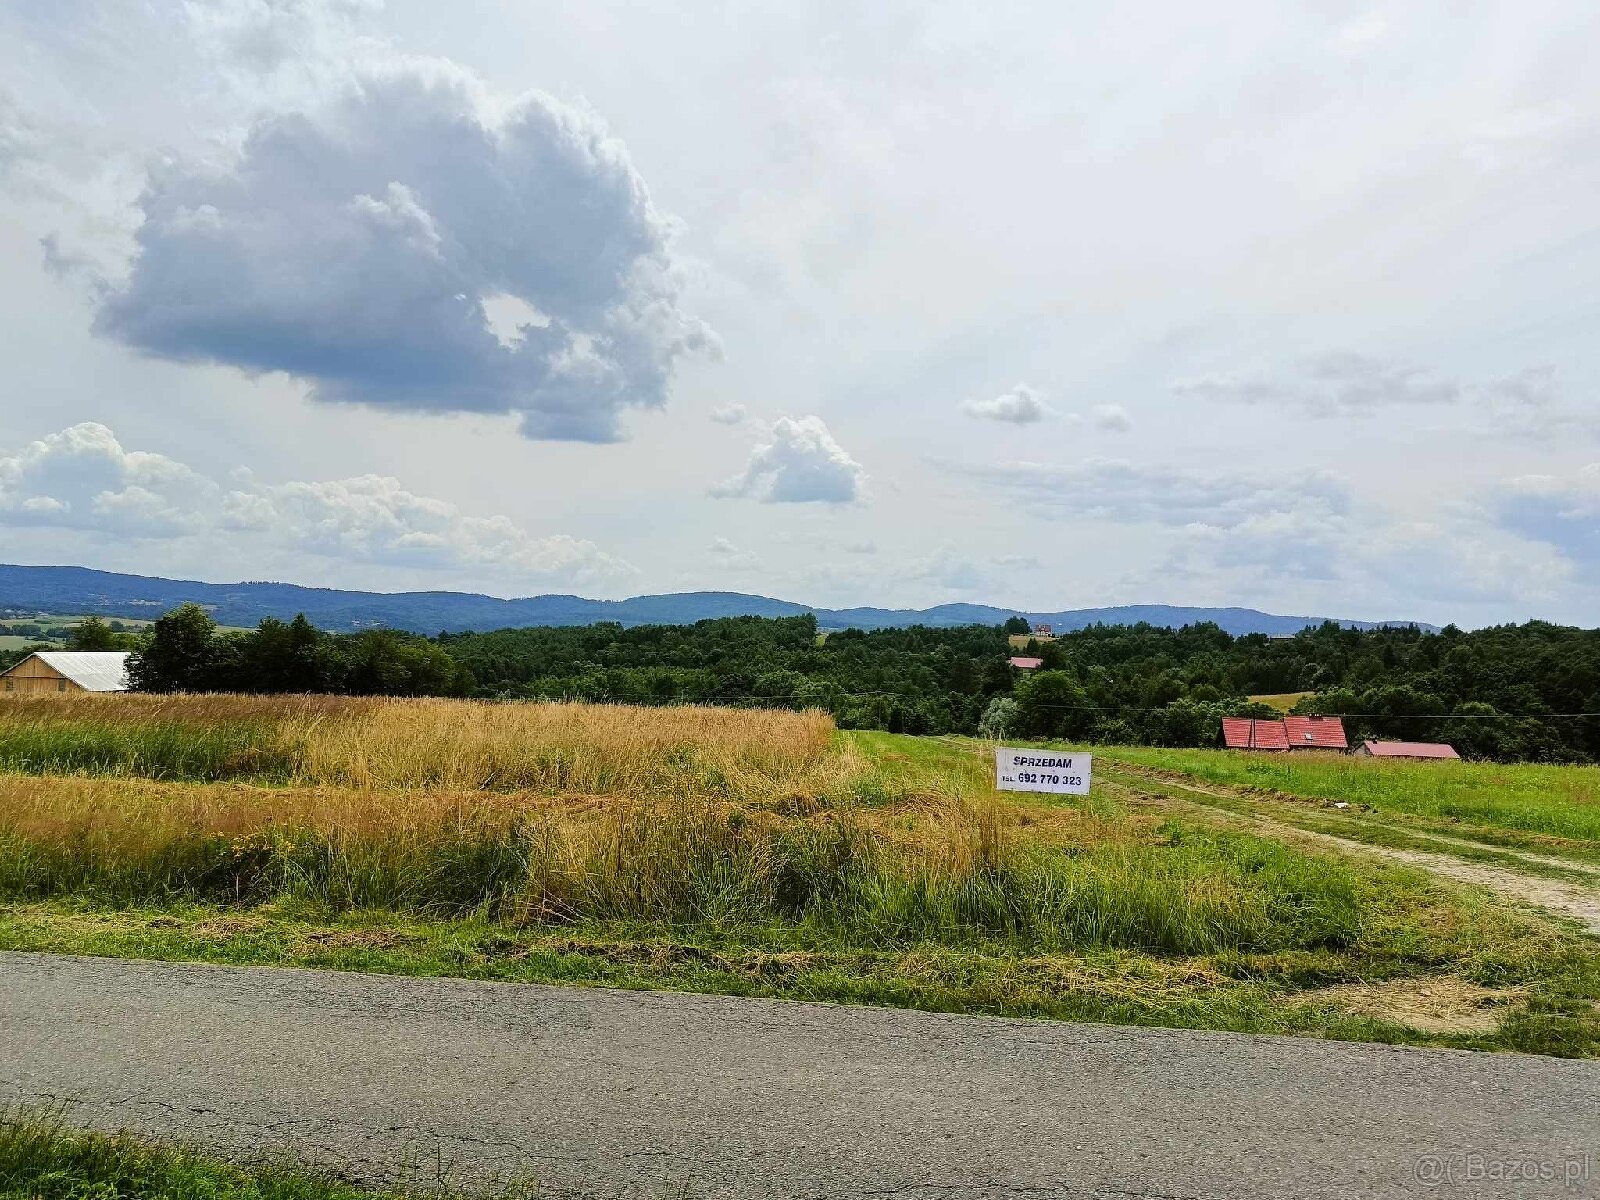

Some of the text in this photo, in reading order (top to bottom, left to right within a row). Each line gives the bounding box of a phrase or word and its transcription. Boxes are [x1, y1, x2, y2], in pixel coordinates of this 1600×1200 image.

[1013, 756, 1072, 768] SPRZEDAM
[1018, 773, 1037, 783] 692
[1040, 774, 1059, 784] 770
[1062, 776, 1082, 786] 323
